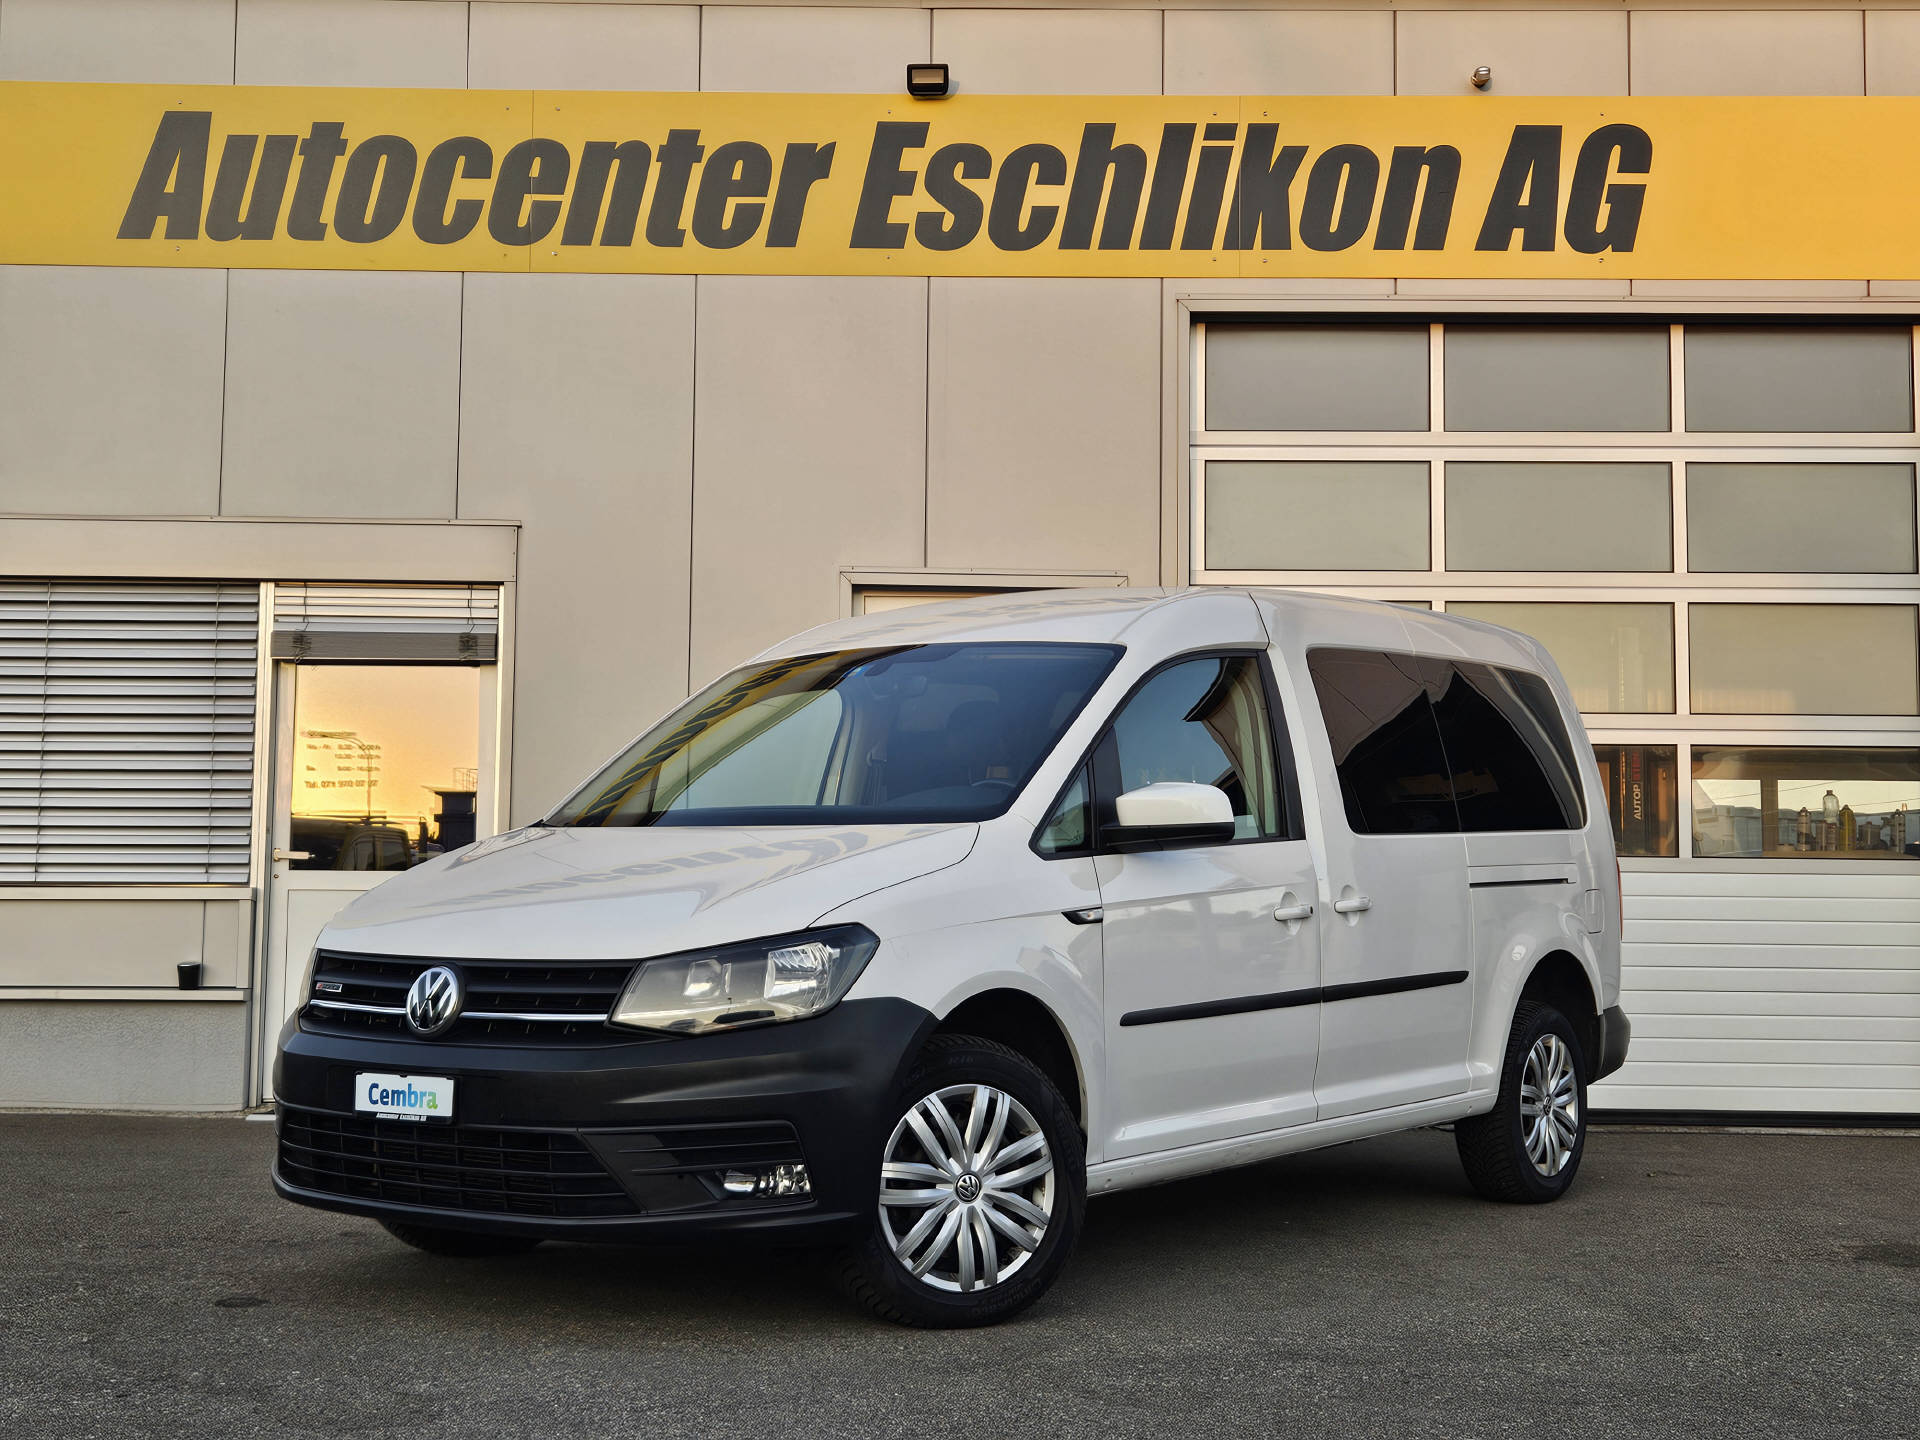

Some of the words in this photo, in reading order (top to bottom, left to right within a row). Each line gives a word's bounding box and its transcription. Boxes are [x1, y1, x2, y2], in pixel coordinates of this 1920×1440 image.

[116, 111, 836, 250] Autocenter
[849, 121, 1462, 252] Eschlikon
[1475, 124, 1654, 253] AG
[1632, 784, 1642, 820] AUTOP
[368, 1082, 438, 1110] Cembra
